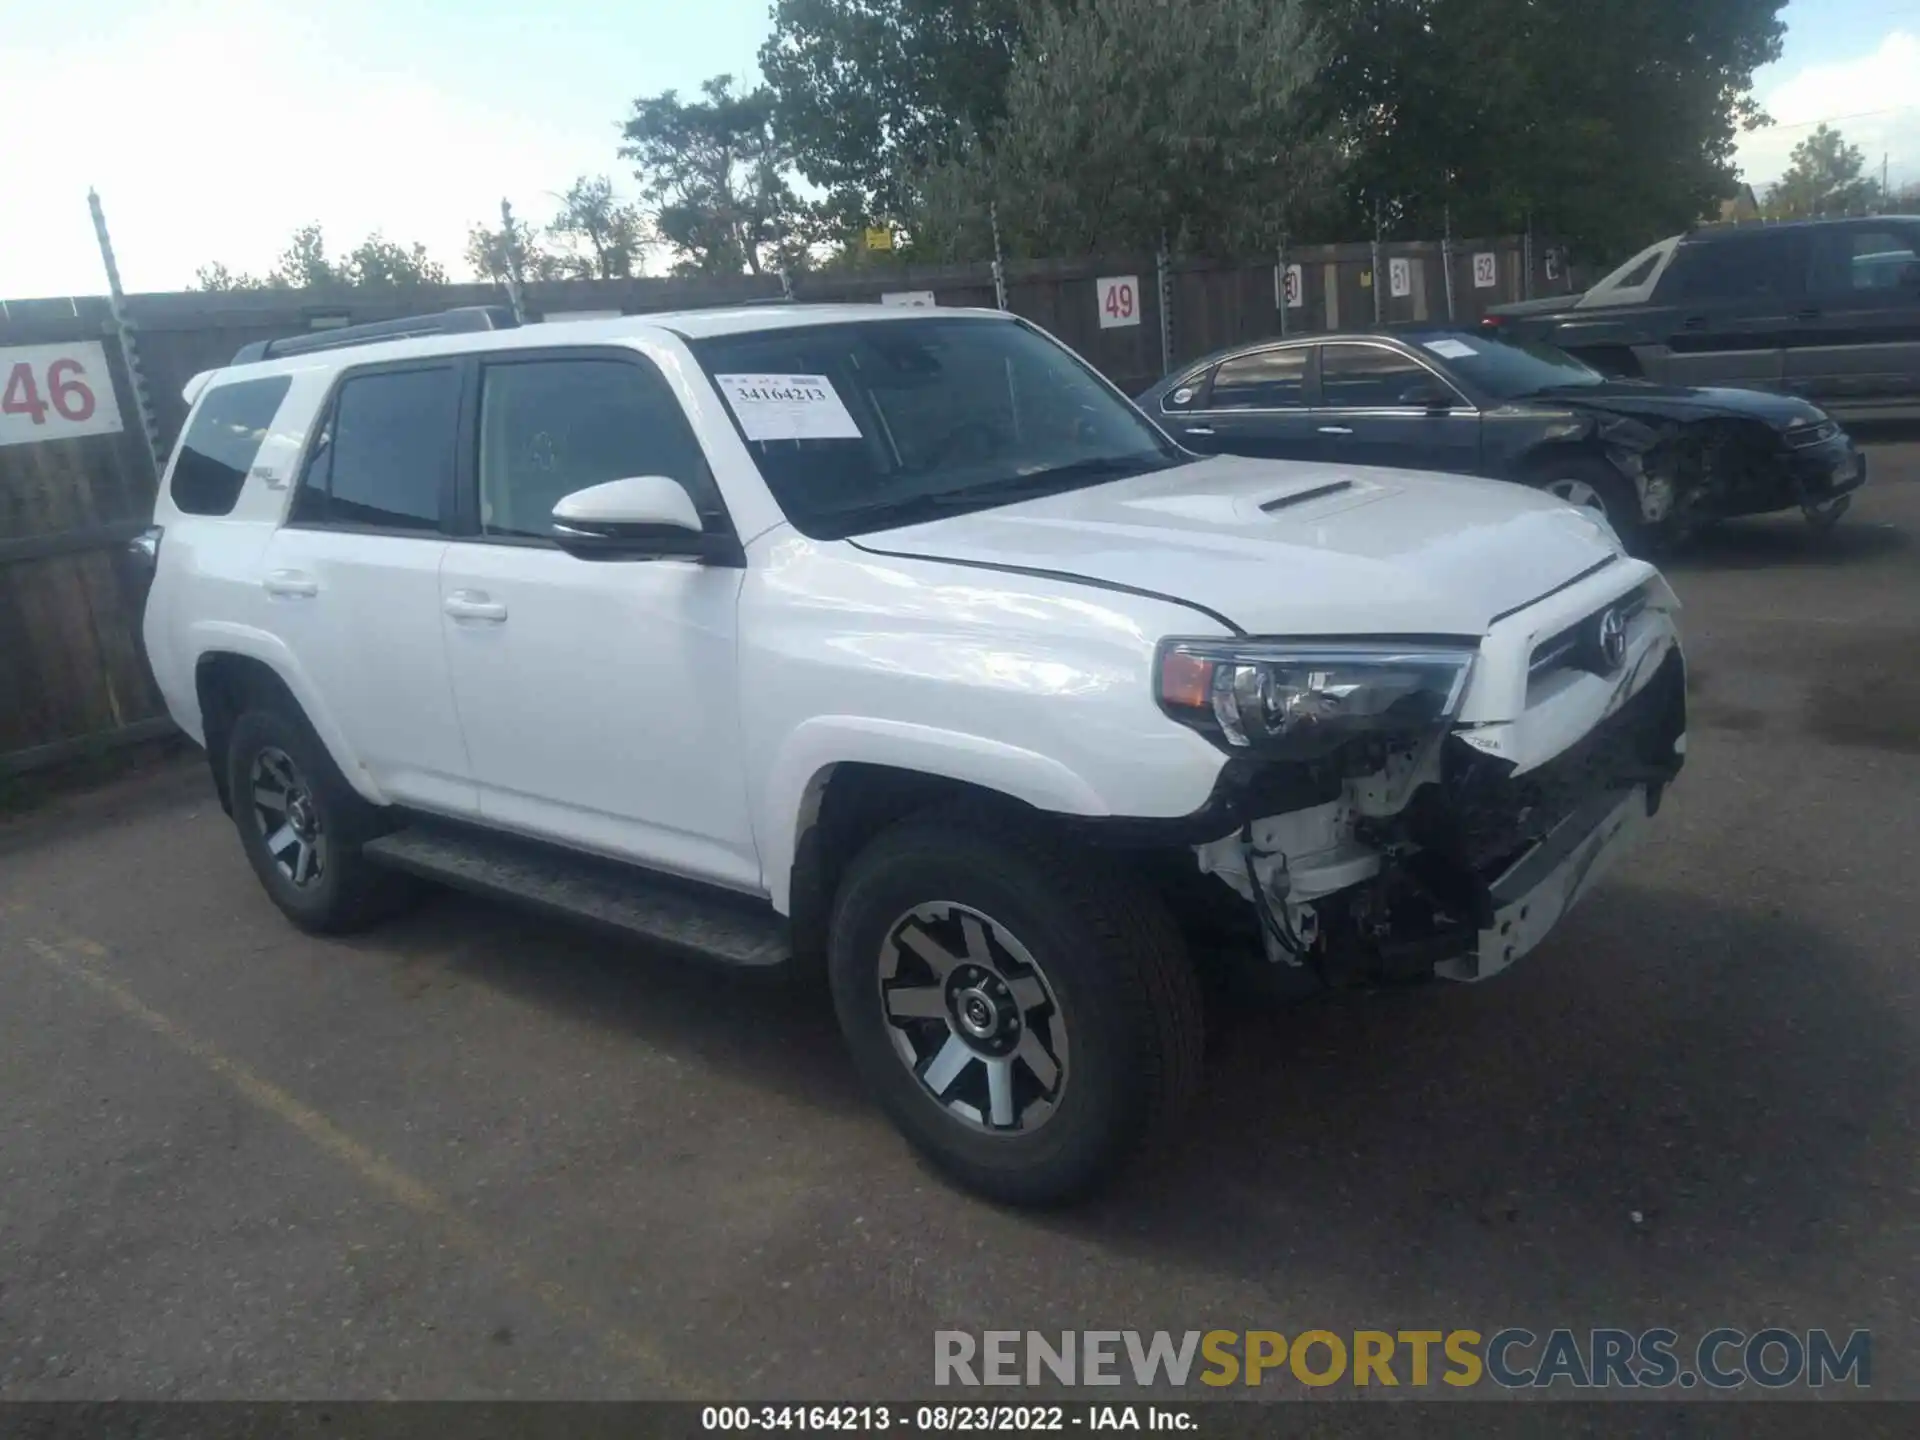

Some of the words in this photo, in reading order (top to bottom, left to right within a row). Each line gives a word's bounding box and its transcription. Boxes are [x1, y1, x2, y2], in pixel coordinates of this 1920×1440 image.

[1477, 257, 1493, 281] 52
[1106, 284, 1132, 318] 49
[2, 357, 96, 425] 46
[736, 387, 826, 401] 34164213
